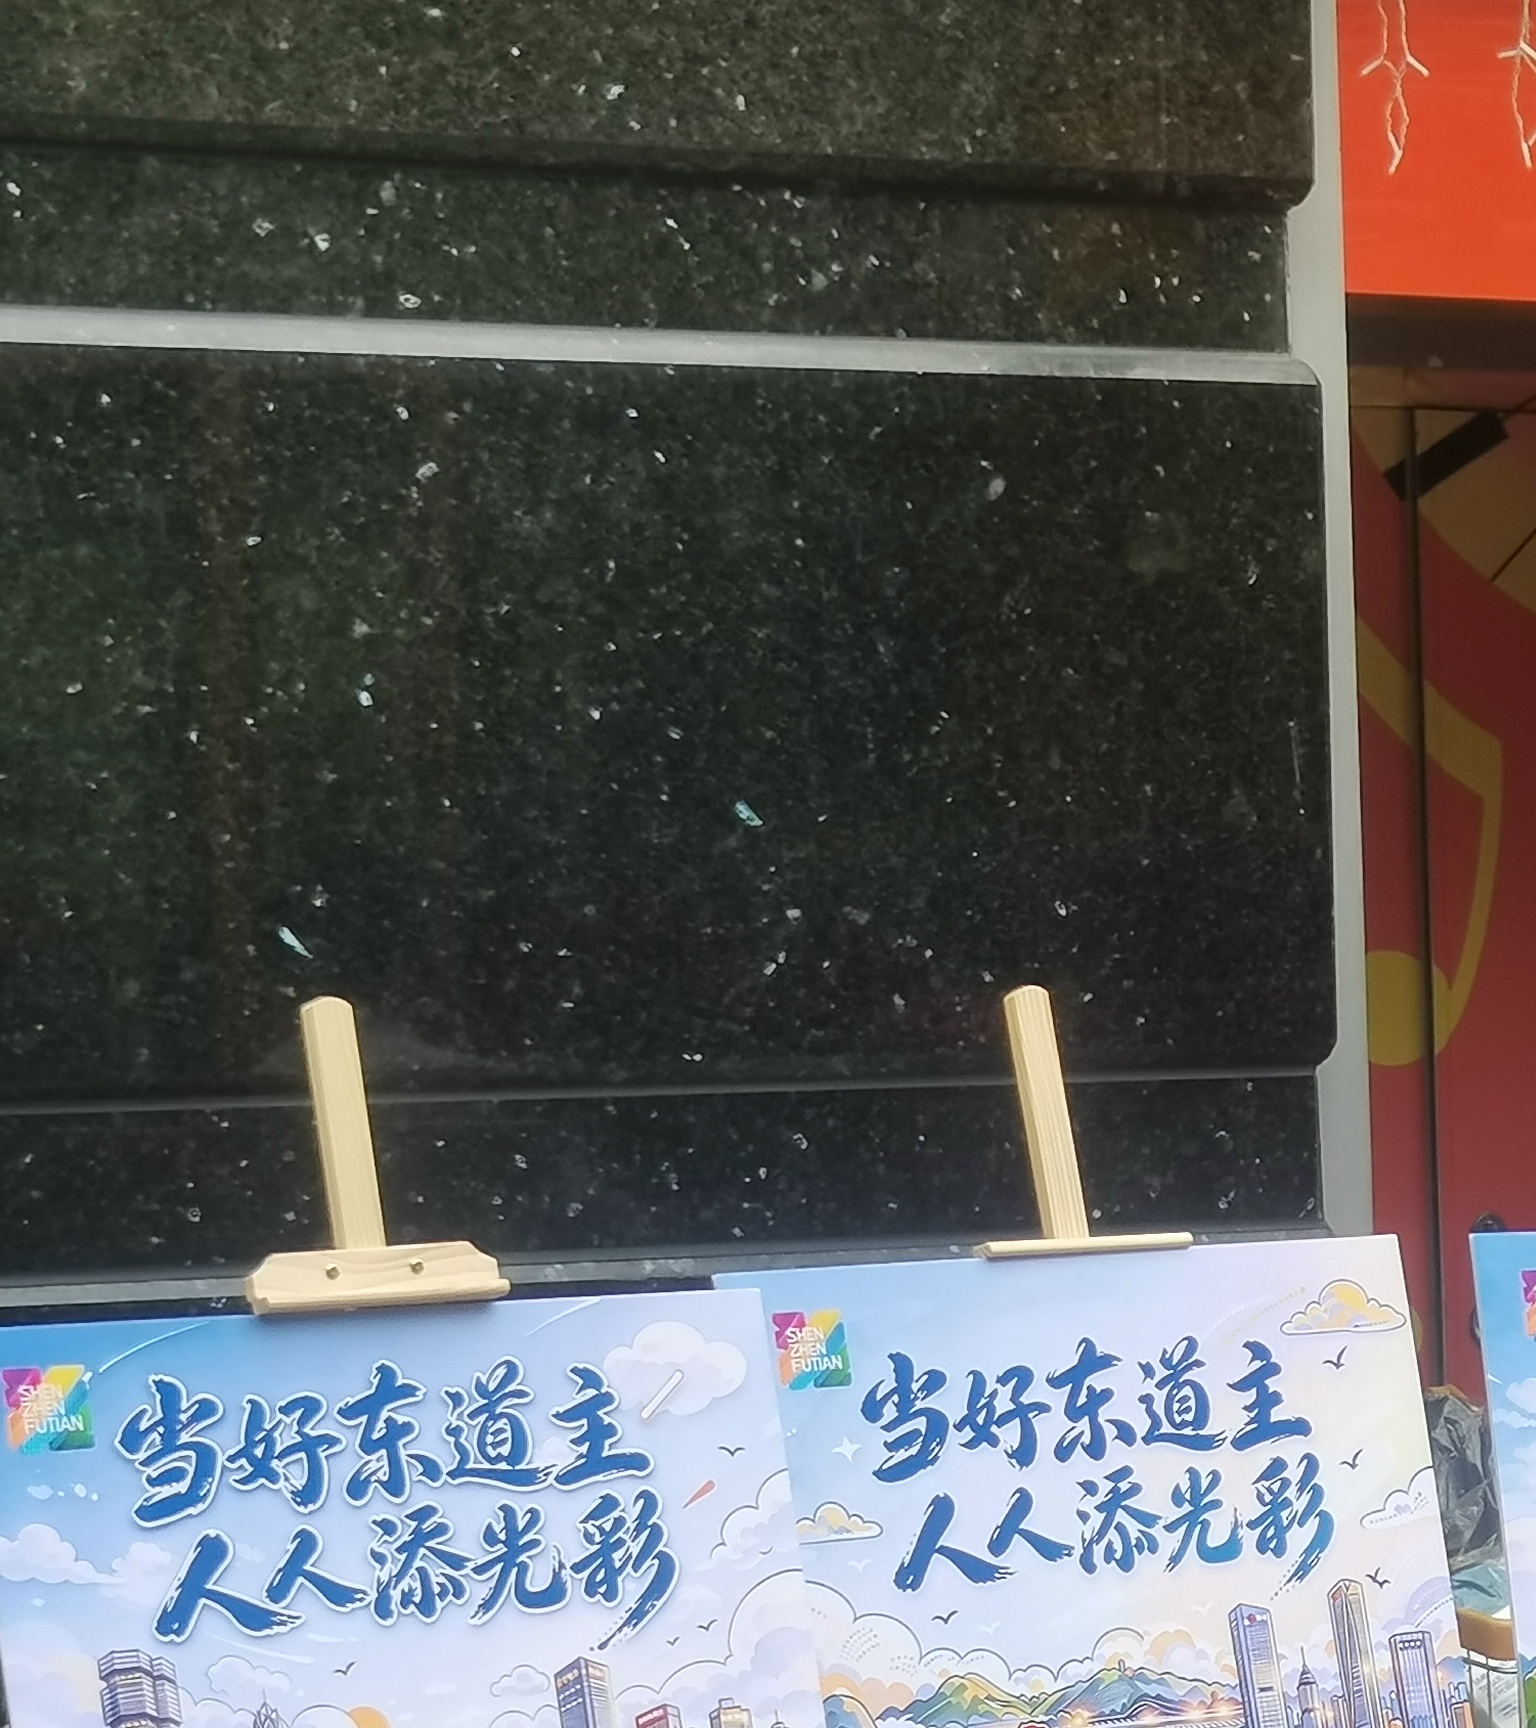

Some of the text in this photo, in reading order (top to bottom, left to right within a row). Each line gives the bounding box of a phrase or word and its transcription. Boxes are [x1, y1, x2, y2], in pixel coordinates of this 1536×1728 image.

[24, 1415, 85, 1435] FUTIAN
[791, 1355, 843, 1373] FUTIAN
[860, 1336, 1312, 1484] 当好东道主
[116, 1359, 653, 1525] 当好东道主
[154, 1488, 682, 1652] 人人添光彩
[893, 1456, 1337, 1598] 人人添光彩
